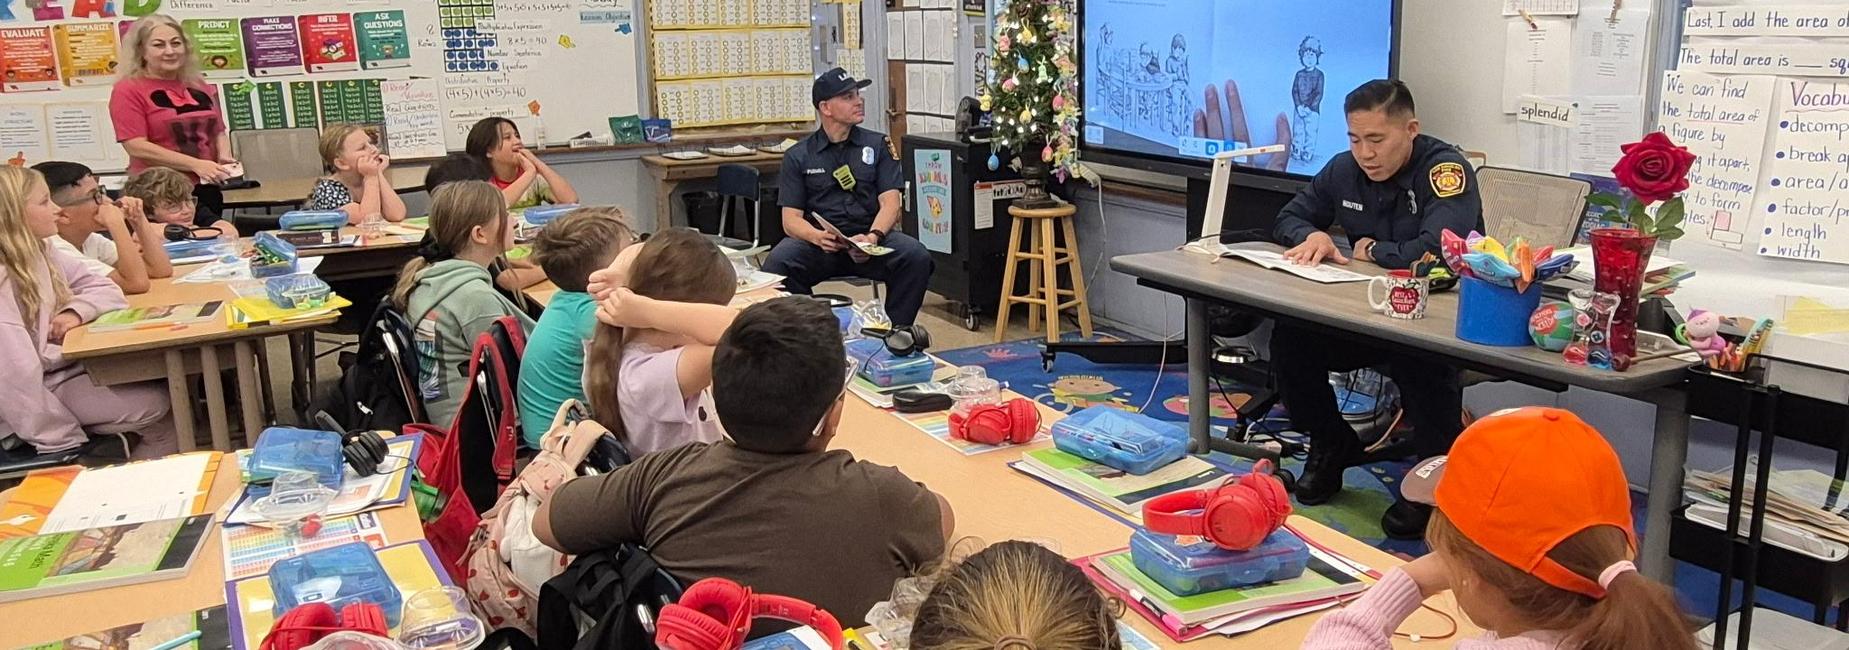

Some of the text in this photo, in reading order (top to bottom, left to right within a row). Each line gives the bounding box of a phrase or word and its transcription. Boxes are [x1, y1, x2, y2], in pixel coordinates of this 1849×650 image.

[66, 23, 110, 33] SUMMARIZE
[198, 20, 230, 29] PREDICT
[252, 23, 293, 31] CONNECTIONS
[364, 20, 403, 29] QUESTIONS
[1717, 11, 1727, 28] I
[1732, 11, 1755, 28] add
[1765, 11, 1788, 28] the
[1796, 17, 1828, 28] area
[1, 29, 46, 39] EVALUATE
[1681, 48, 1702, 64] The
[1710, 48, 1738, 66] total
[1743, 56, 1772, 66] area
[1778, 54, 1789, 66] is
[1667, 74, 1748, 99] We can find
[1521, 103, 1569, 121] splendid
[1663, 101, 1760, 122] the total area of
[1672, 122, 1705, 143] figure
[1712, 127, 1726, 149] by
[1708, 153, 1716, 167] it
[1789, 145, 1831, 163] break
[1696, 192, 1707, 206] to
[1712, 193, 1741, 210] form
[1781, 222, 1827, 245] length
[1777, 243, 1821, 259] width
